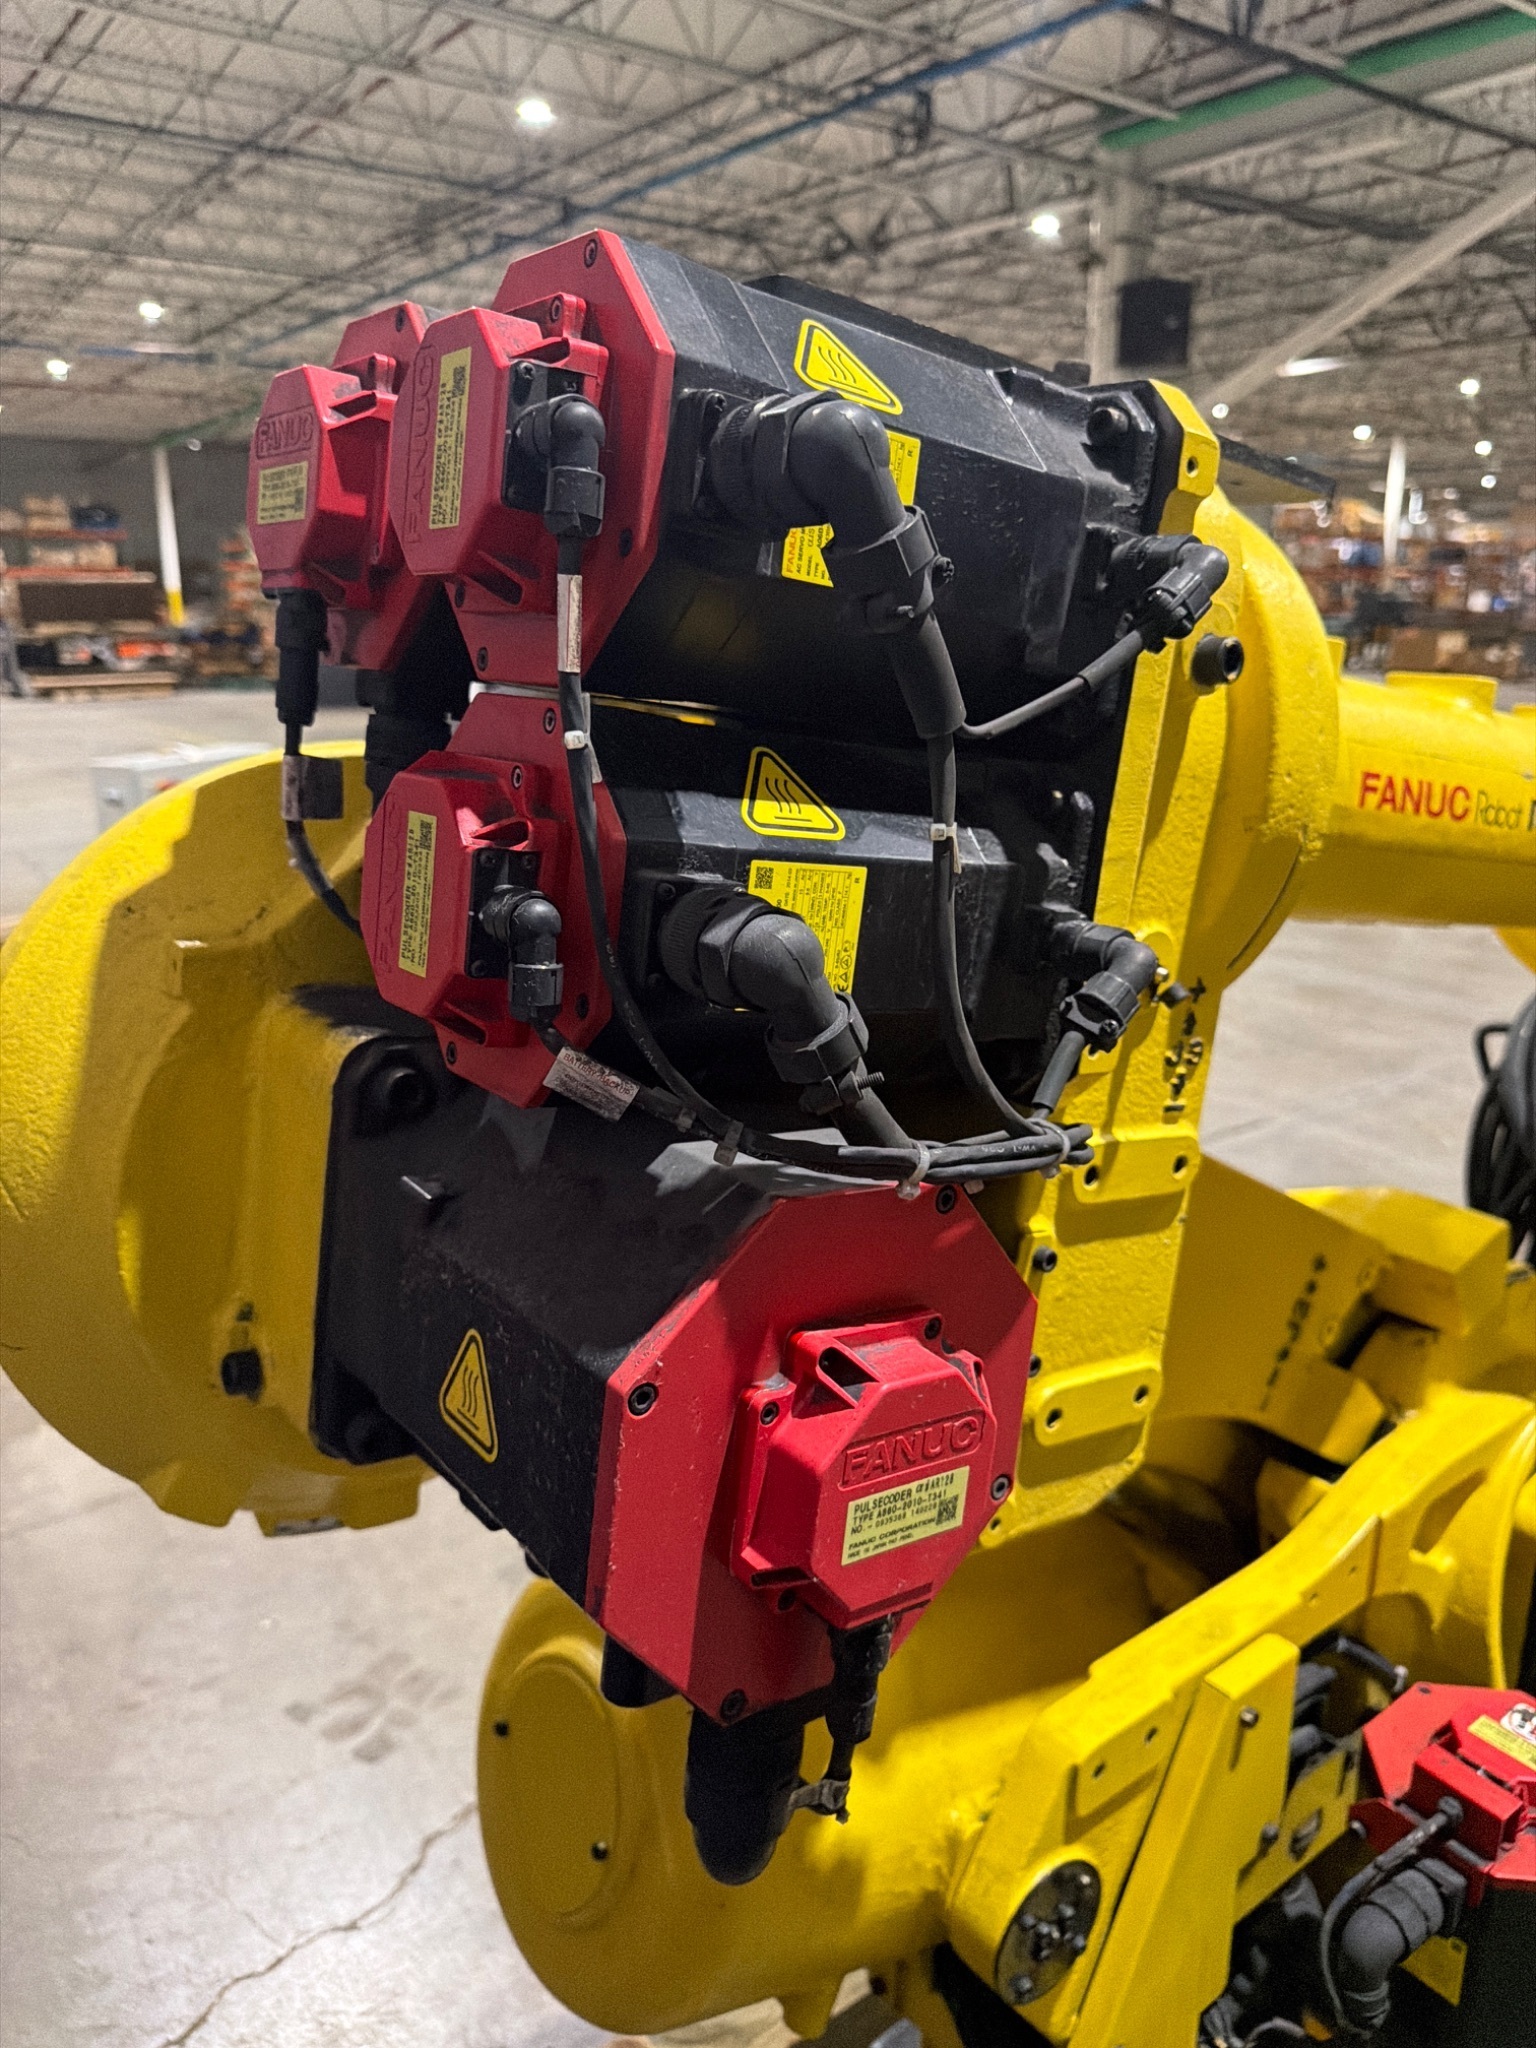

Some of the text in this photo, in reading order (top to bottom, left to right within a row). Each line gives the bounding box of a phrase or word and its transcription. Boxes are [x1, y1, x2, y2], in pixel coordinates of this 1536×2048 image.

[258, 411, 313, 453] FANUC
[432, 443, 443, 525] PULSECODER
[797, 536, 805, 562] SERVO
[1358, 770, 1470, 821] FANUC
[1474, 789, 1523, 829] Robot
[402, 885, 411, 958] PULSECODER
[842, 1416, 978, 1486] FANUC
[853, 1512, 873, 1525] TYPE
[854, 1488, 913, 1515] PULSECODER
[849, 1516, 935, 1549] FANUC CORPORATION
